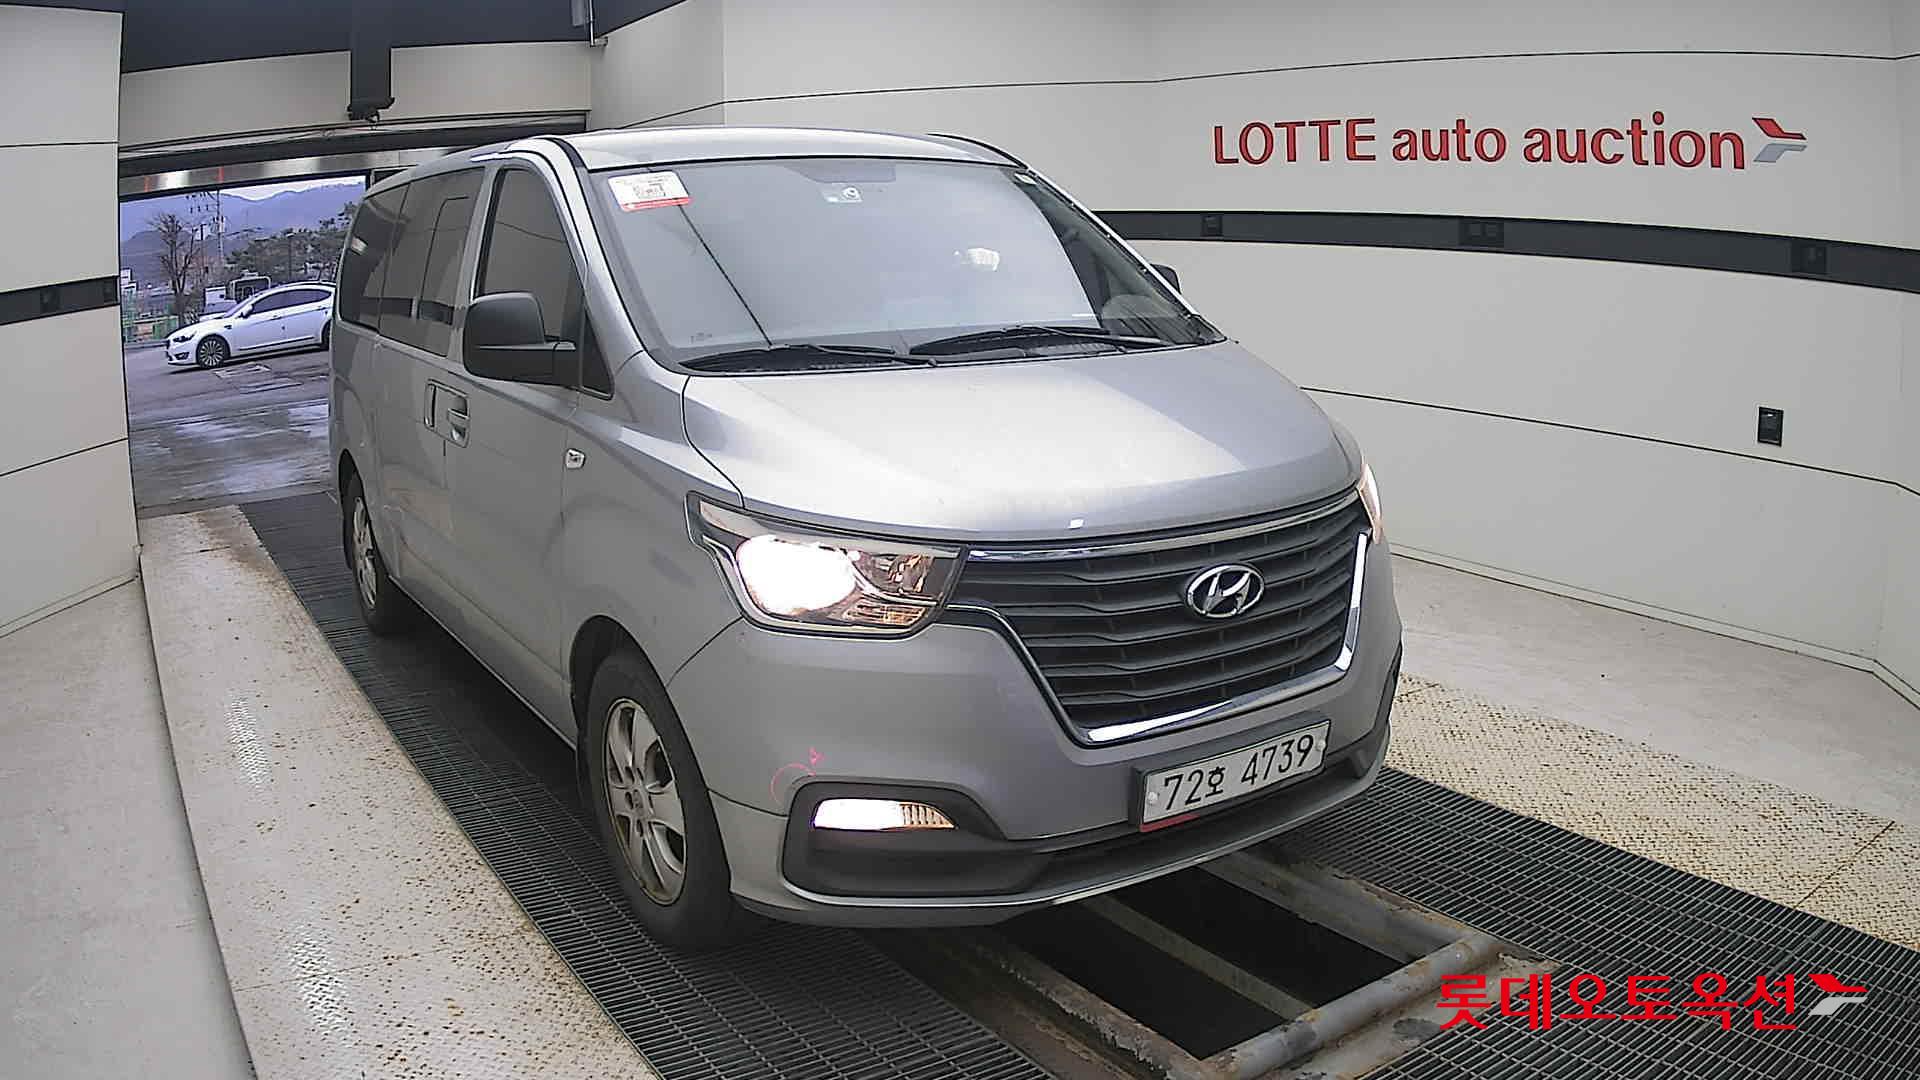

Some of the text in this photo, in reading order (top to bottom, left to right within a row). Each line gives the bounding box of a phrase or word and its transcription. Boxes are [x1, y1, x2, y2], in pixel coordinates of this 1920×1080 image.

[1213, 111, 1746, 170] LOTTE auto auction
[1163, 734, 1315, 811] 72호 4739
